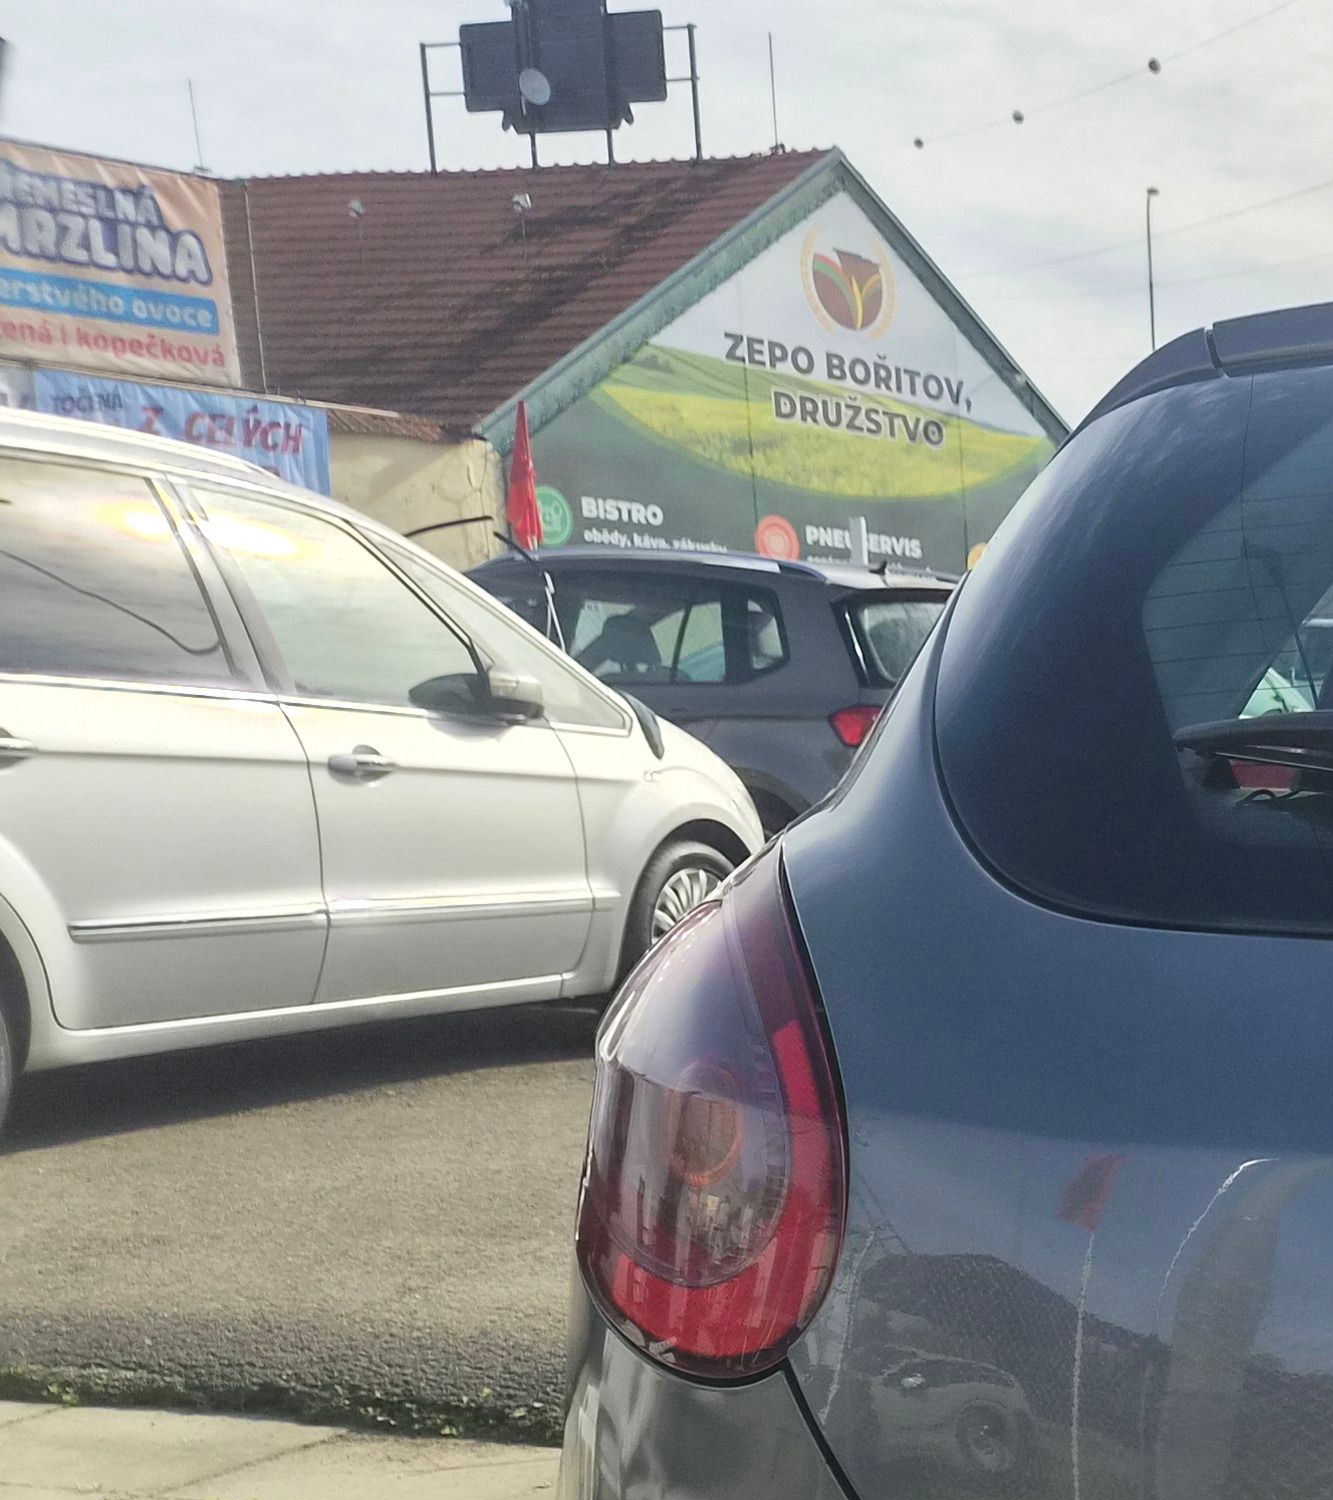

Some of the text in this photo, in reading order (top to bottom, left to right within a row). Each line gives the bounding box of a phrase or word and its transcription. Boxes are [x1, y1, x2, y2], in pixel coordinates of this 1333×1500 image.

[131, 299, 213, 329] ovoce
[75, 325, 226, 369] kopečková
[724, 331, 972, 414] ZEPO BOŘITOV,
[772, 390, 945, 447] DRUŽSTVO
[581, 496, 664, 527] BISTRO
[805, 525, 923, 559] PNEERVIS
